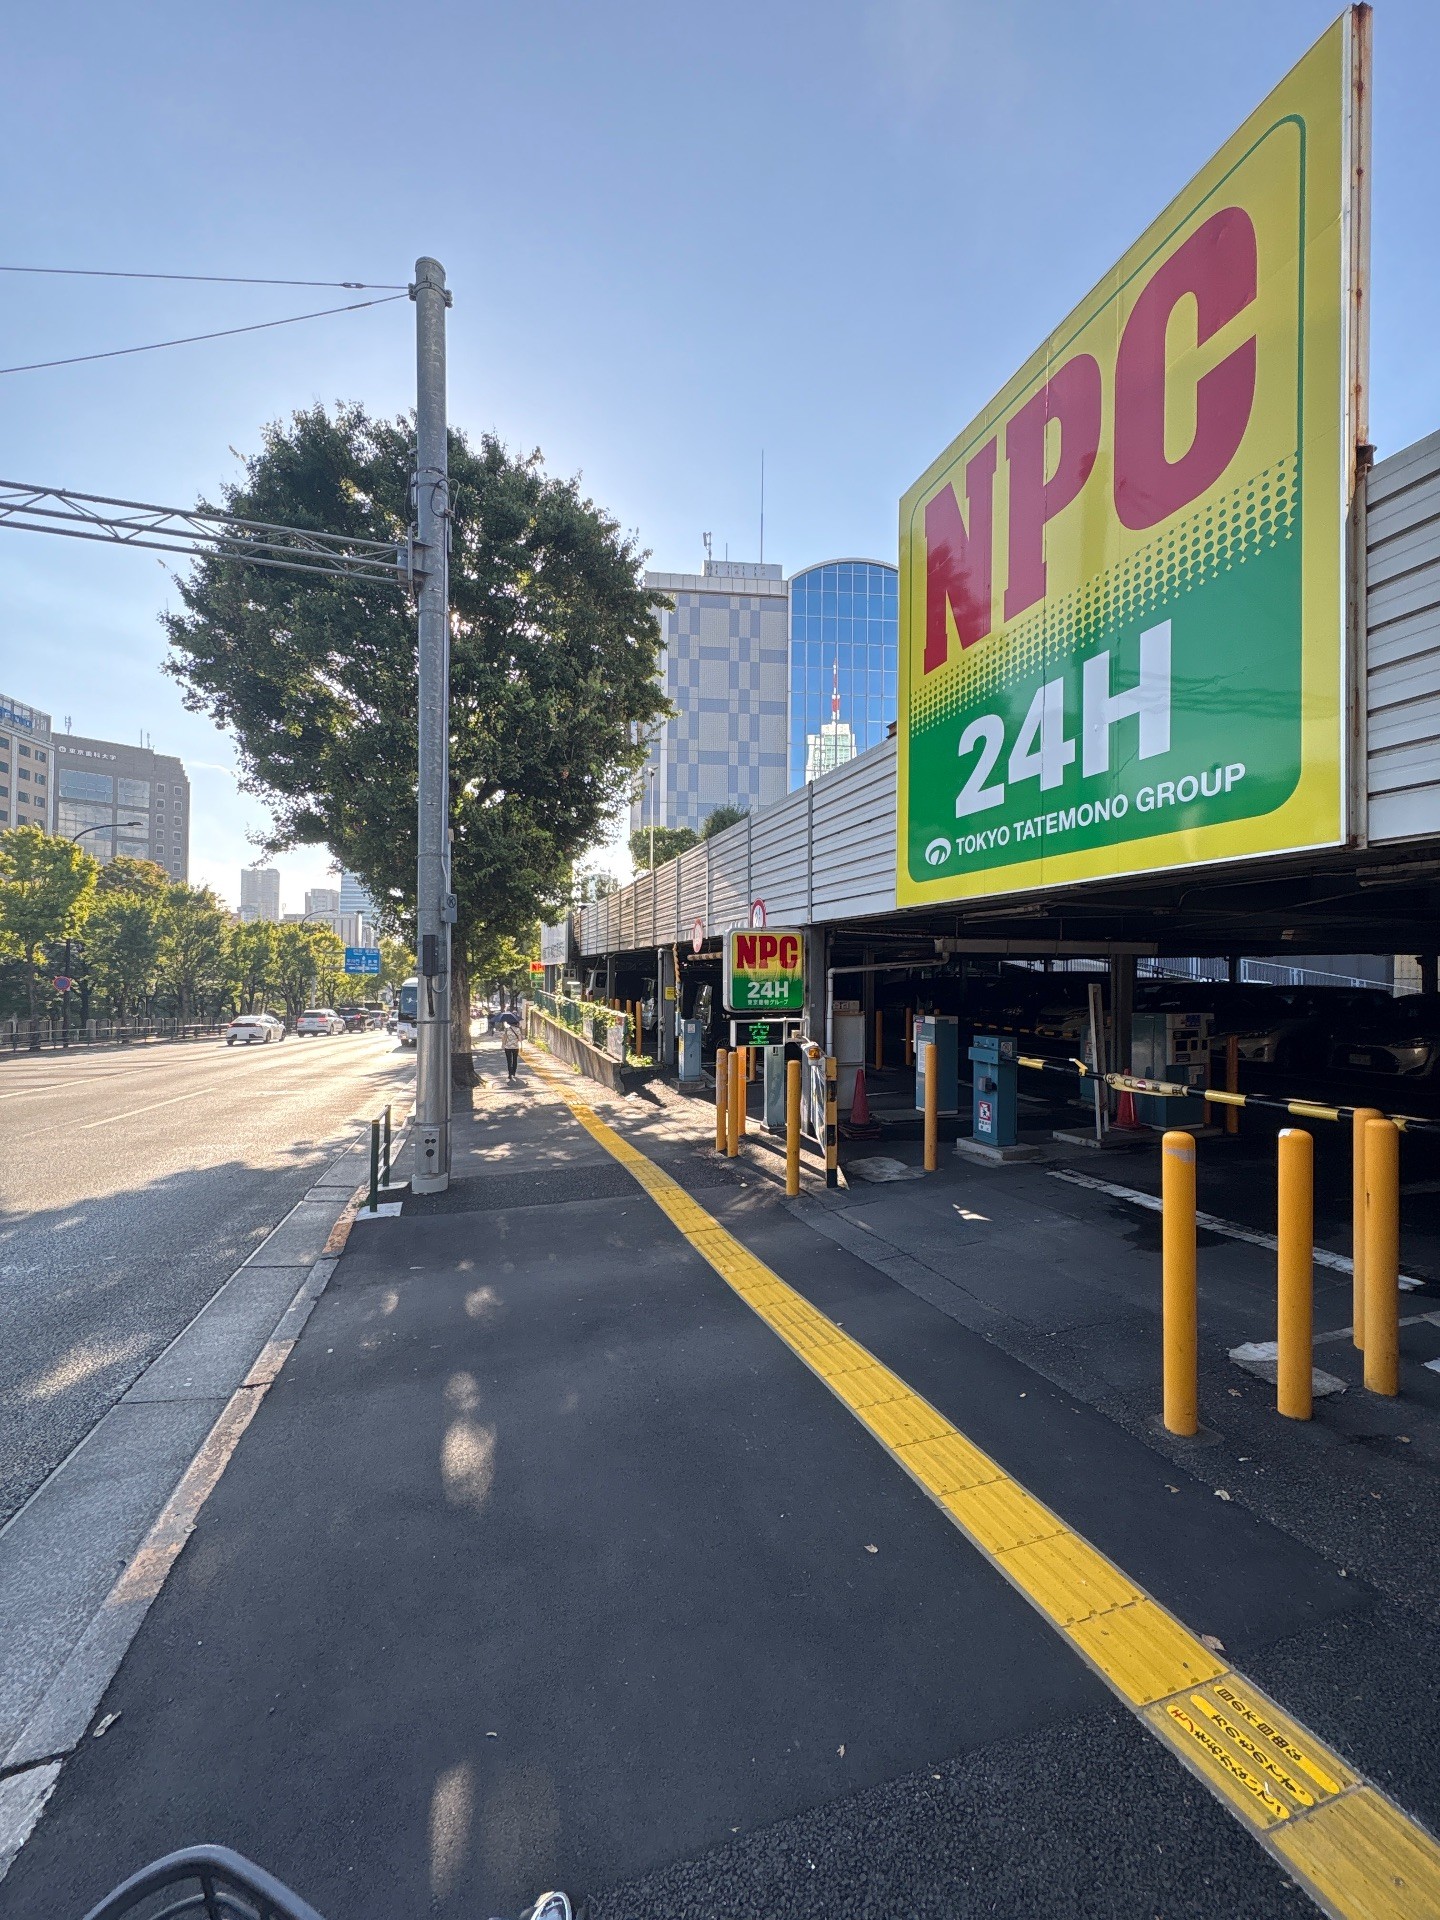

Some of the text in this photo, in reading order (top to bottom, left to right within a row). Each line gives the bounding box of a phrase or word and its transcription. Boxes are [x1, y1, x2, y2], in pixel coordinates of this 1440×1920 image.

[924, 206, 1257, 674] NPC
[956, 619, 1172, 818] 24H
[956, 762, 1246, 856] TOKYO TATEMONO GROUP
[736, 935, 798, 969] NPC
[747, 981, 789, 998] 24H
[1211, 1713, 1306, 1796] 方のものです。
[1216, 1688, 1301, 1761] 目の不自由な
